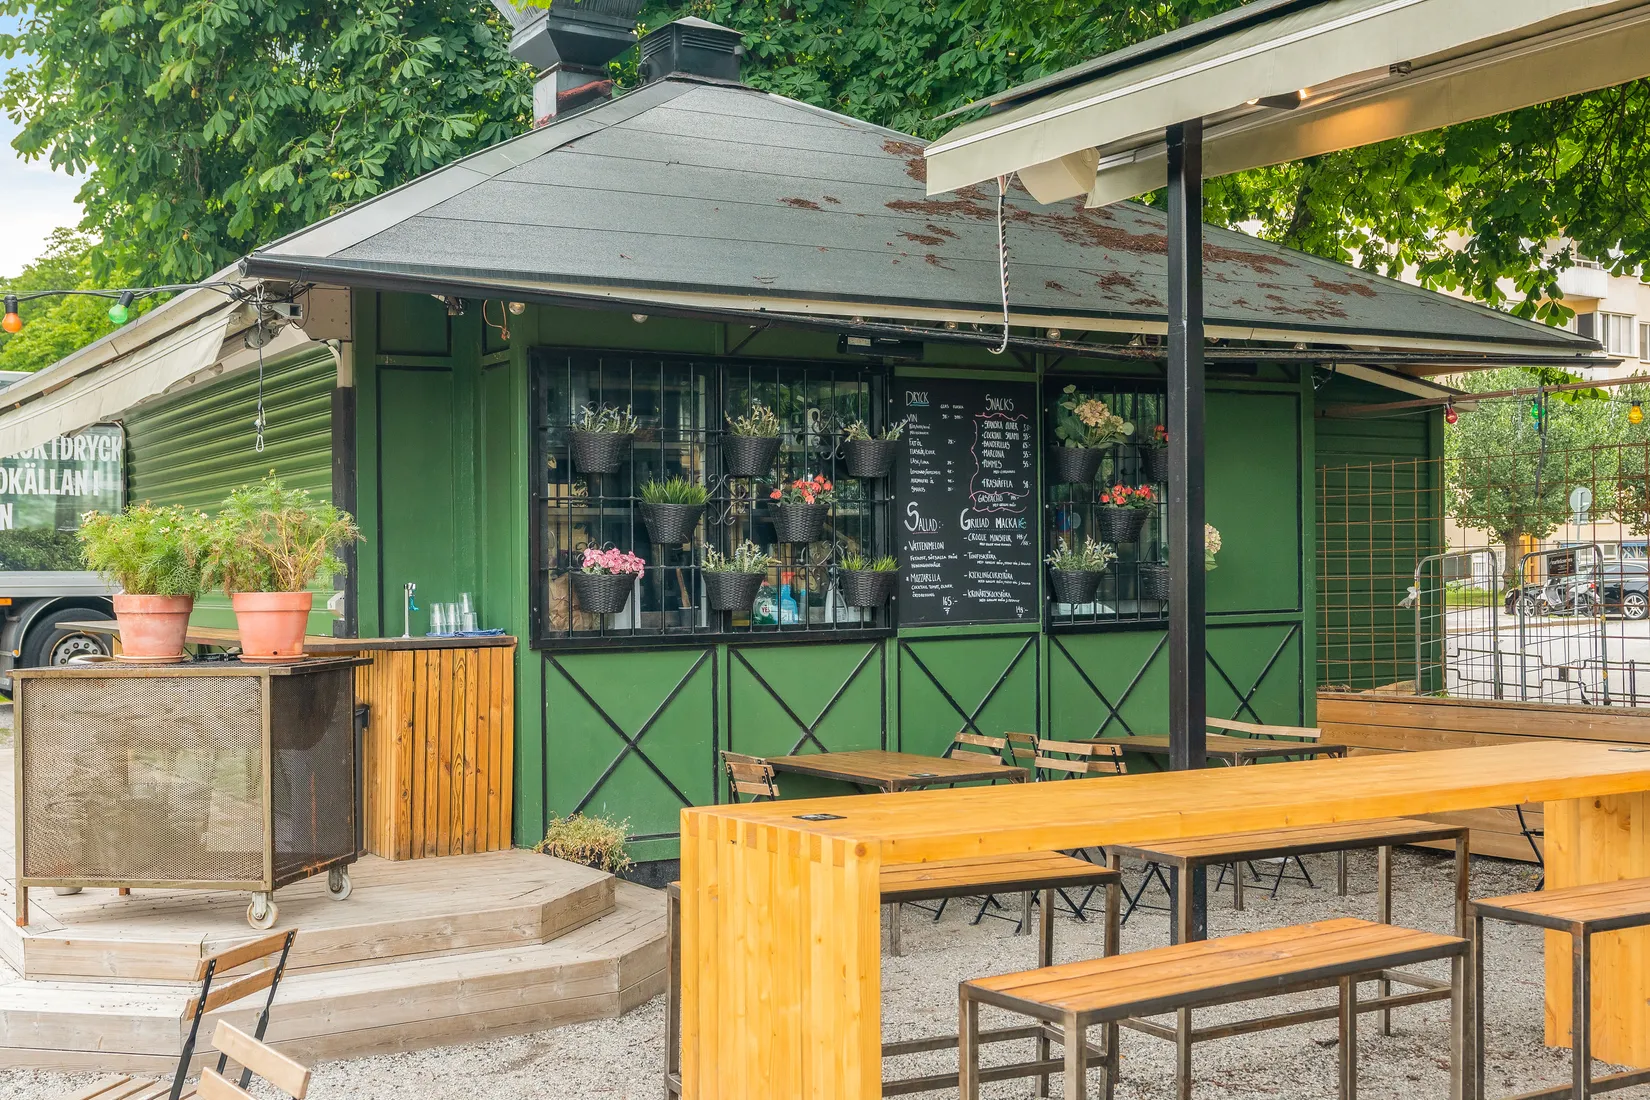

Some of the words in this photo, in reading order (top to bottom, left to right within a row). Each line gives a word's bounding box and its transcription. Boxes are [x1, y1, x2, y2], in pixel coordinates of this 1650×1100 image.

[905, 390, 930, 406] DRYCK
[986, 394, 1014, 411] SNACKS
[906, 413, 918, 423] VIN
[1005, 432, 1019, 440] SALAMI
[983, 440, 1010, 450] BANDERILLAS
[983, 449, 1005, 458] MARCONA
[983, 459, 1002, 469] POMMES
[960, 507, 990, 530] GRILLAD
[908, 540, 944, 551] VATTENMELON
[910, 573, 941, 582] MOZZARELLA
